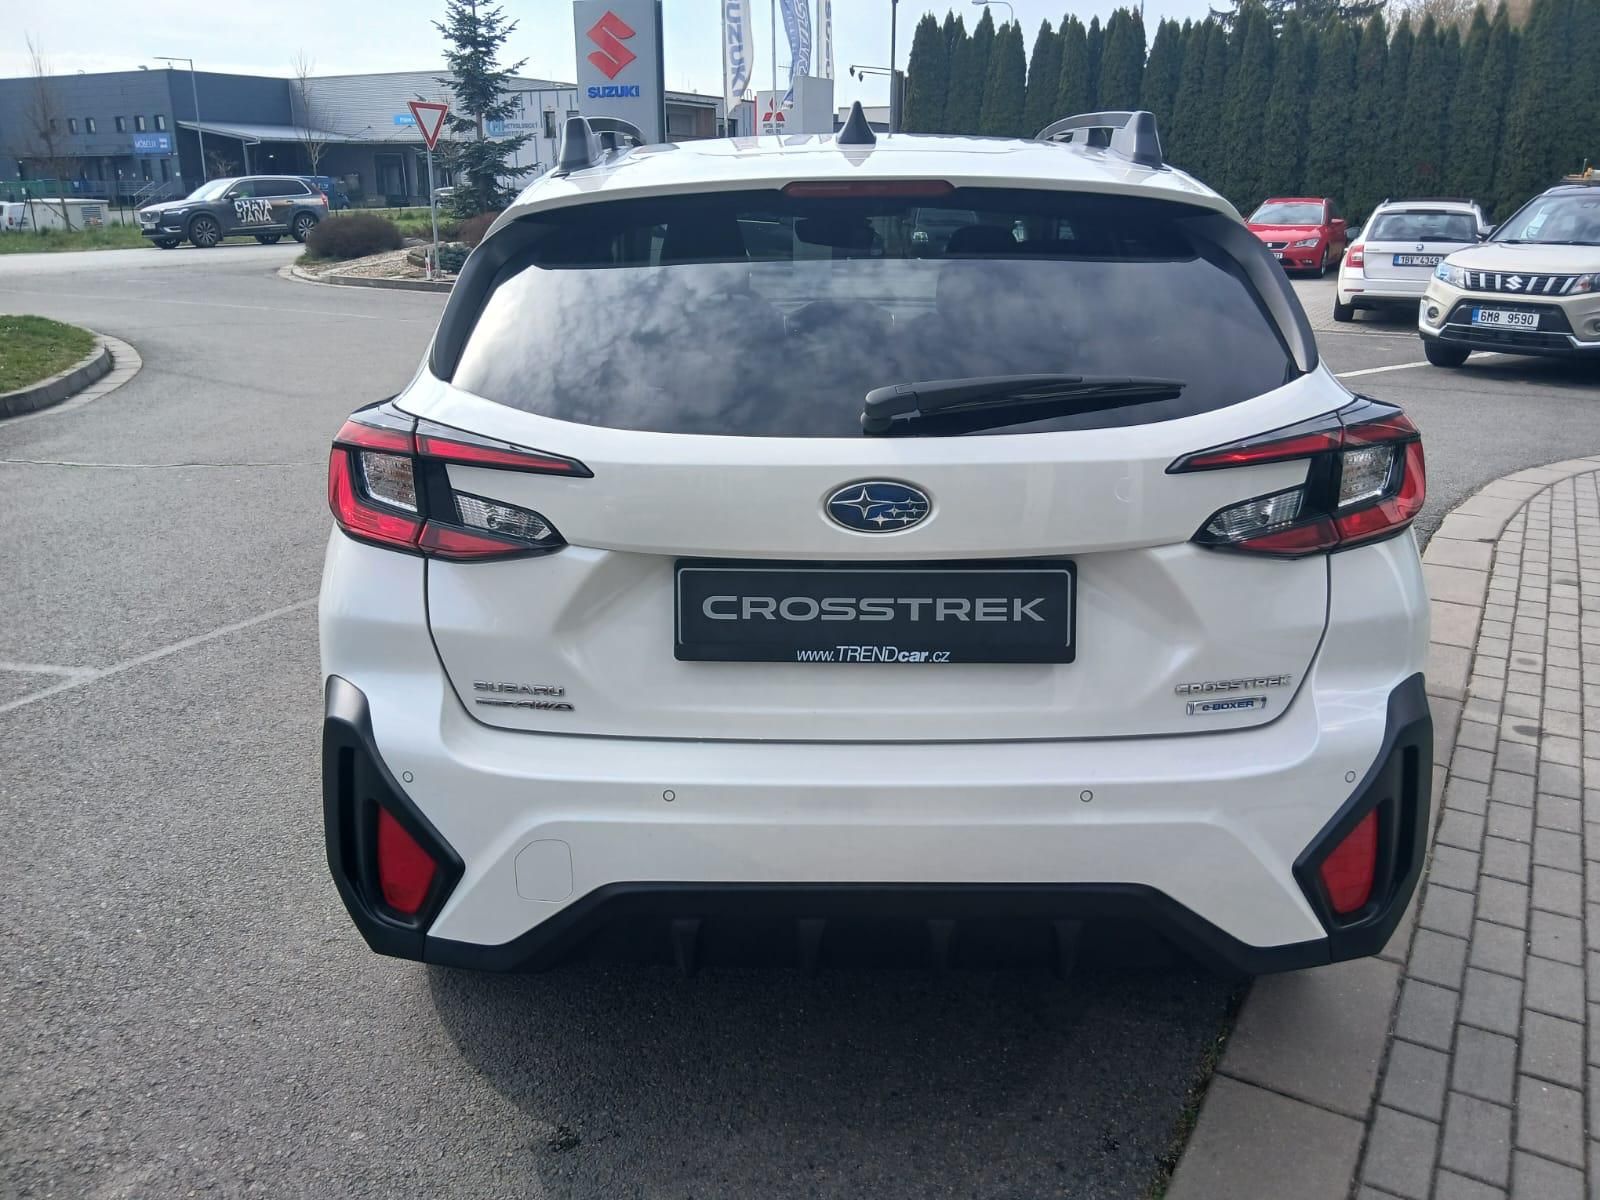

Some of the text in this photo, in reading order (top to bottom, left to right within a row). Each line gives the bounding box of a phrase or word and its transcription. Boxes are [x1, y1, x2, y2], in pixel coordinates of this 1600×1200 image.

[726, 0, 747, 97] UZUKI
[587, 86, 640, 98] SUZUKI
[241, 210, 272, 222] JANA
[1480, 311, 1534, 326] 6M8 9590
[702, 595, 1046, 622] CROSSTREK
[796, 645, 951, 664] www.TRENDcar.cz
[473, 680, 565, 697] SUBARU
[1175, 674, 1292, 695] CROSSTREK
[1202, 700, 1254, 711] e-BOXER
